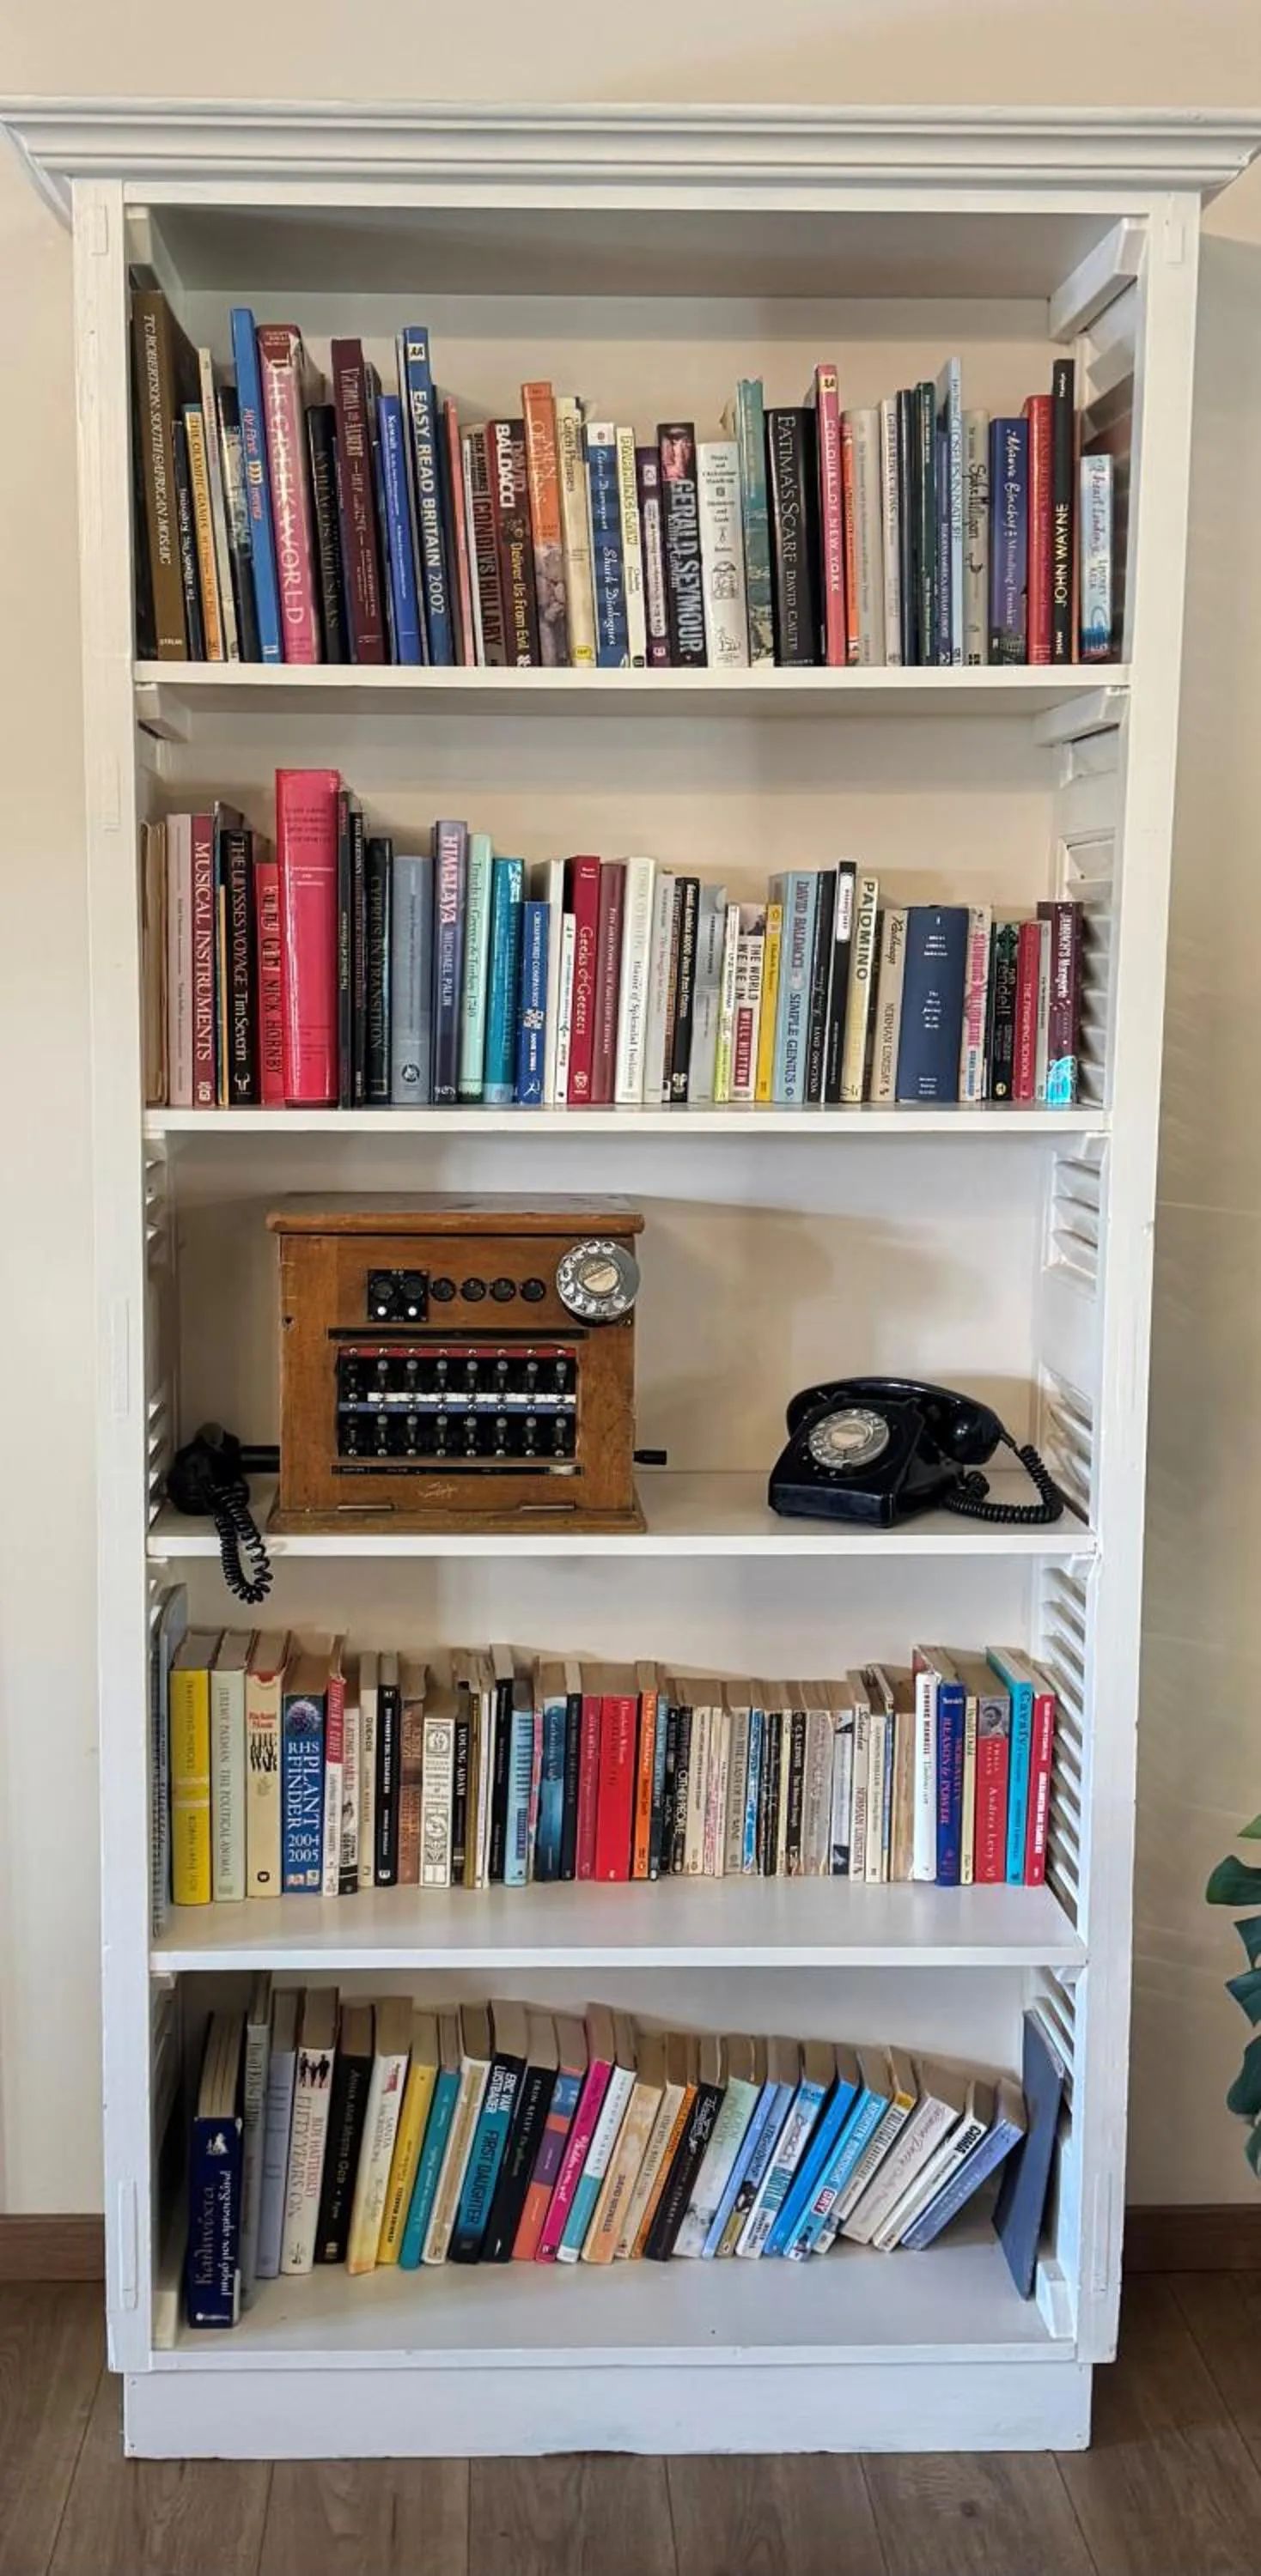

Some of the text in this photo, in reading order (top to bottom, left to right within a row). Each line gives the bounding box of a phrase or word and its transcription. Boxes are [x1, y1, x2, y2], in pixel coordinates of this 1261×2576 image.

[498, 424, 515, 507] BALDACCI
[777, 416, 798, 499] FATIMA'S
[413, 391, 444, 615] EASY READ BRITAIN 2002
[473, 501, 495, 553] CONDI
[781, 501, 800, 562] SCARF
[825, 419, 840, 592] COLOURS OF NEW YORK
[280, 514, 305, 624] WORLD
[510, 542, 524, 580] Deliver
[513, 583, 525, 596] Us
[671, 480, 704, 653] GERALD SEYMOUR
[786, 570, 797, 606] DAVID
[1055, 504, 1069, 608] JOHN WAYNE
[479, 577, 502, 645] HILLARY
[514, 599, 526, 627] From
[195, 841, 212, 1061] MUSICAL INSTRUMENTS
[231, 841, 248, 1061] THE ULYSSES VOYAGE Tim Severin
[440, 835, 459, 1006] HIMALAYA MICHAEL PALIN
[577, 927, 594, 966] Geeks
[856, 881, 877, 981] PALOMINO
[369, 876, 383, 1048] CYPRUS IN TRANSITION
[748, 945, 762, 1000] THE WORLD
[784, 881, 810, 1084] DAVID BALDACCI SIMPLE GENIUS
[996, 959, 1012, 1016] rendell
[264, 979, 283, 1074] NICK HORNBY
[576, 983, 591, 1035] Geezers
[737, 1012, 752, 1084] WILL HUTTON
[289, 1741, 320, 1753] RHS
[456, 1728, 467, 1795] YOUNG ADAM
[288, 1755, 303, 1829] FINDER
[303, 1755, 320, 1830] PLANT
[985, 1787, 998, 1859] Andrea Levy
[288, 1850, 320, 1862] 2005
[295, 2094, 311, 2140] FIFTY
[503, 2073, 517, 2093] ERIC
[290, 2141, 308, 2189] YEARS
[466, 2129, 499, 2225] FIRST DAUGHTER
[814, 2190, 837, 2214] DRY
